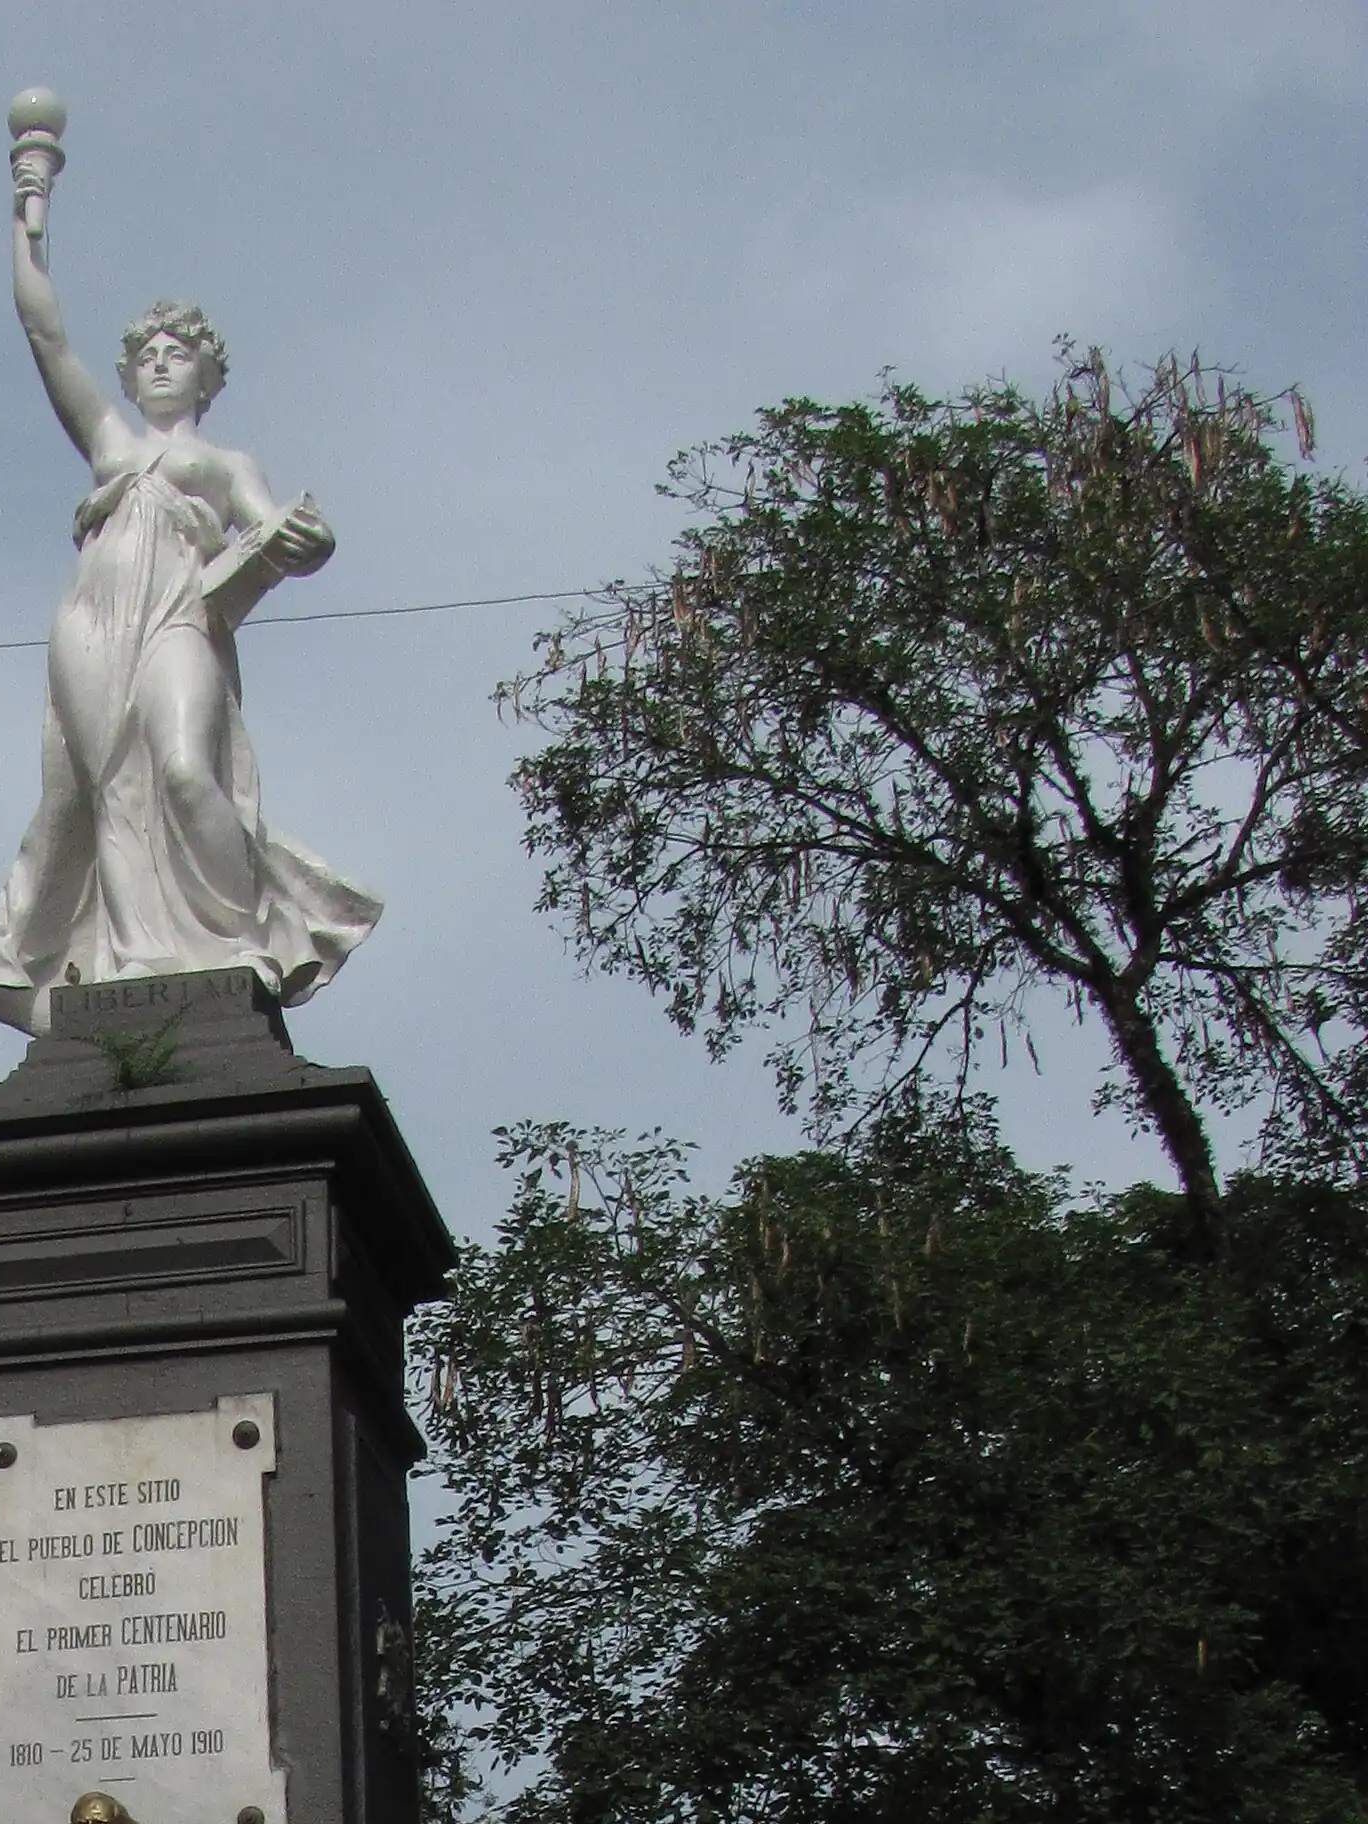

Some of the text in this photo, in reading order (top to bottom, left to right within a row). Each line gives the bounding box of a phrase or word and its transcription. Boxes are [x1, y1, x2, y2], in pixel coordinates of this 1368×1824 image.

[52, 973, 248, 1015] LIBERTAD
[54, 1478, 180, 1511] EN ESTE SITIO
[28, 1534, 93, 1561] PUEBLO
[102, 1531, 124, 1555] DE
[133, 1517, 239, 1552] CONCEPCION
[16, 1610, 226, 1652] EL PRIMER CENTENARIO
[56, 1662, 178, 1698] DE LA PATRIA
[10, 1743, 42, 1766] 1810
[71, 1739, 93, 1763] 25
[101, 1736, 122, 1760] DE
[131, 1732, 182, 1758] MAYO
[190, 1729, 224, 1754] 1910
